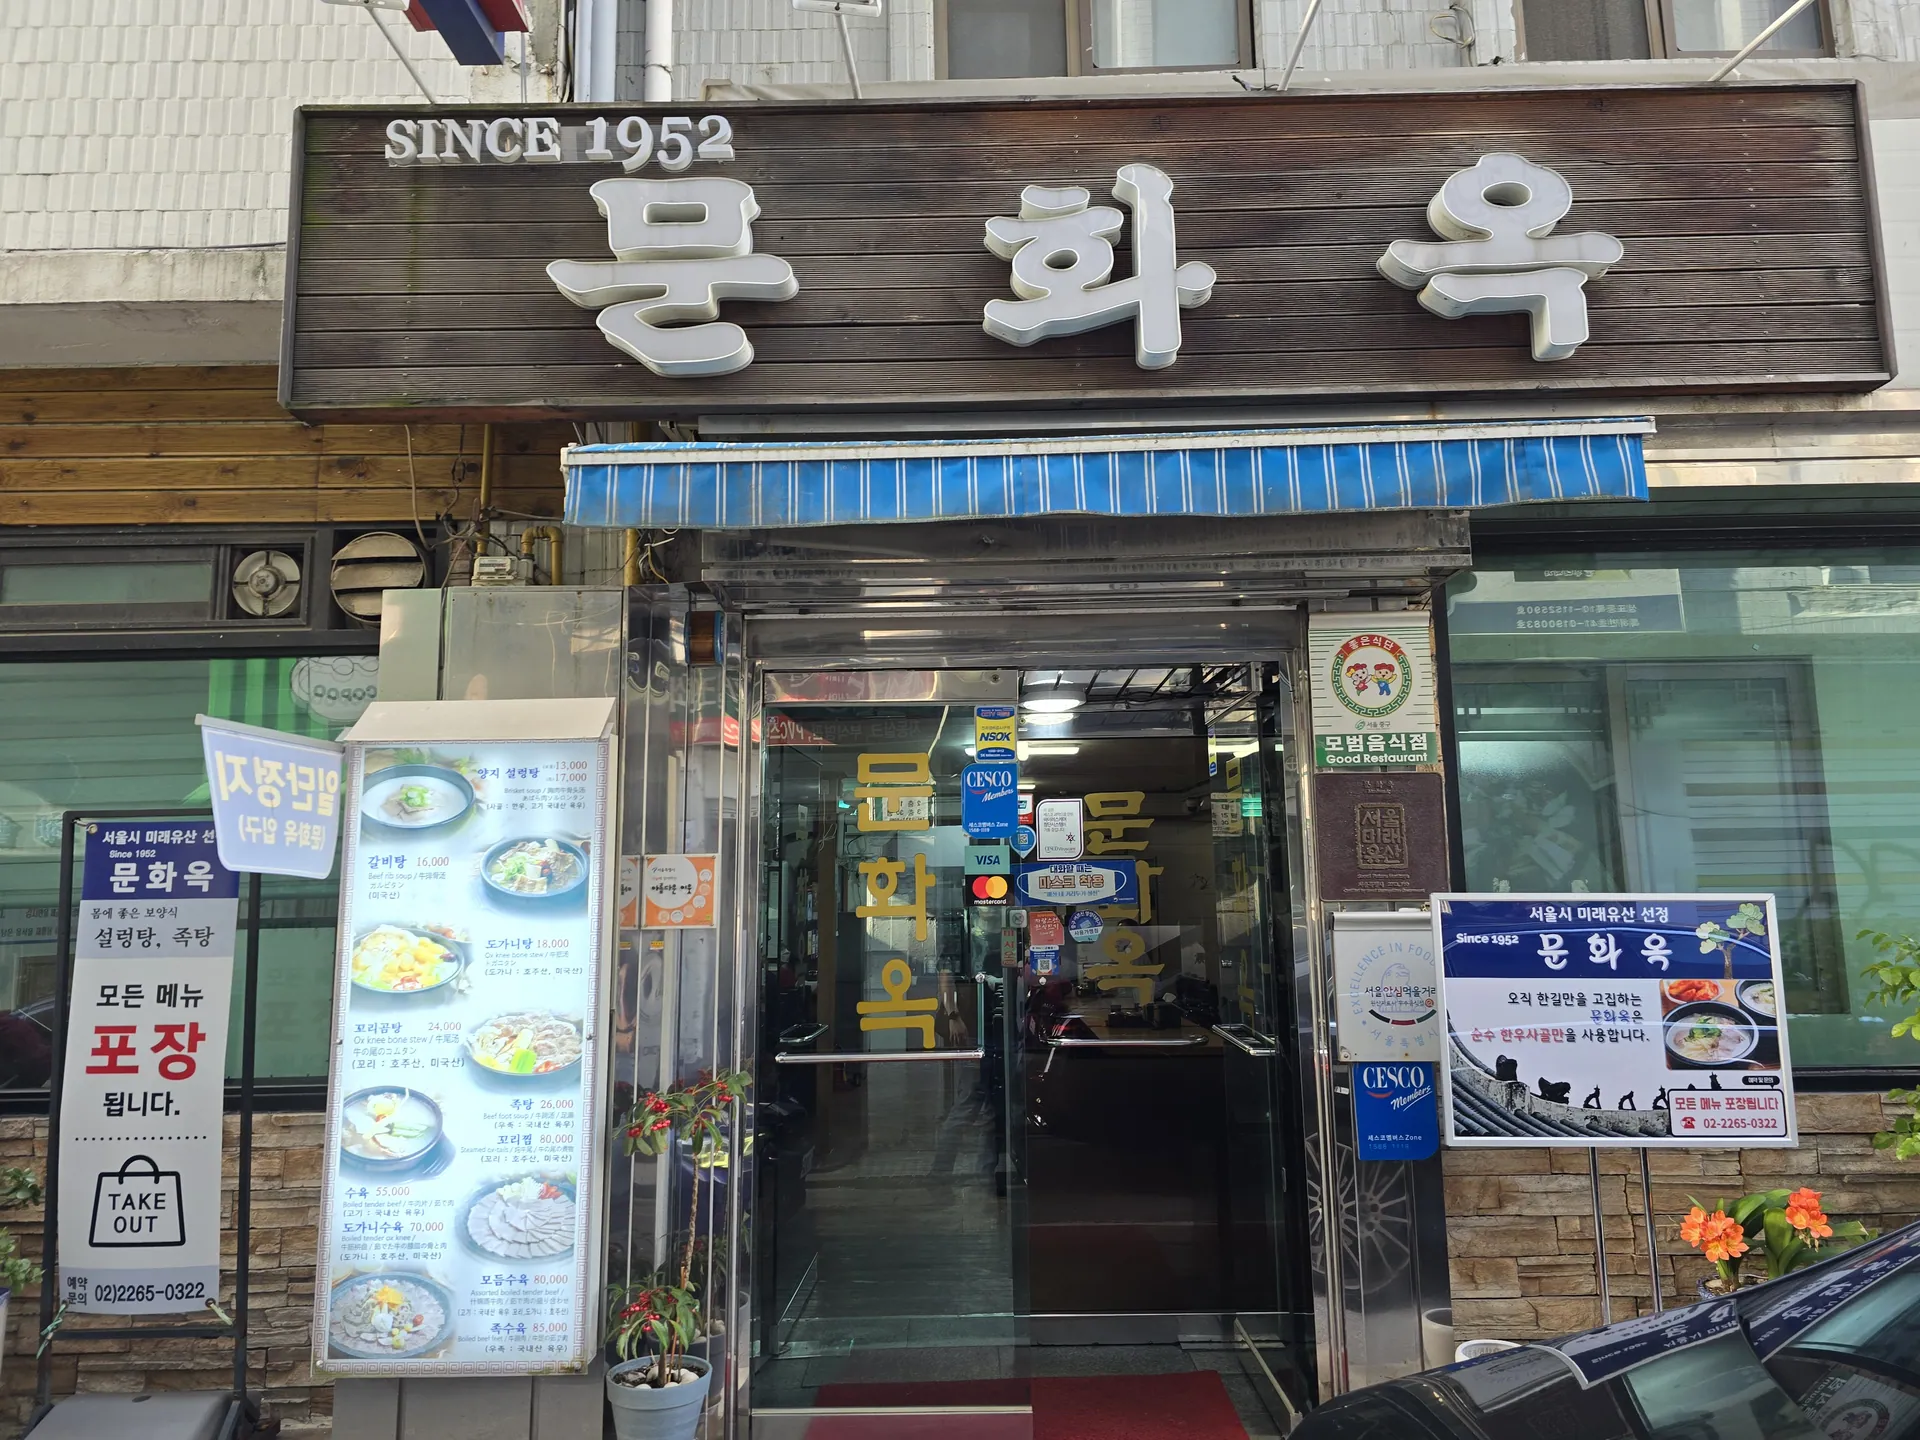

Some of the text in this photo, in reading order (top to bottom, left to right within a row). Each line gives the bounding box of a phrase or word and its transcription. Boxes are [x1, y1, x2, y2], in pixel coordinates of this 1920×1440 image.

[384, 114, 735, 173] SINCE 1952
[545, 152, 1625, 379] 문화옥
[1366, 720, 1377, 729] 서울
[979, 732, 1012, 741] NSOK
[1325, 733, 1428, 753] 모범음식점
[1326, 752, 1427, 764] Good Restaurant
[477, 768, 500, 779] 양지
[505, 767, 540, 779] 설렁탕
[555, 761, 587, 771] 13,000
[555, 773, 587, 782] 17,000
[966, 770, 1012, 787] CESCO
[981, 787, 1014, 803] Members
[102, 829, 197, 846] 서울시 미래유산
[109, 849, 156, 858] Since 1952
[974, 855, 1000, 865] VISA
[368, 855, 449, 869] 갈비탕 16,000
[1049, 864, 1092, 873] 대화할 때는
[109, 860, 214, 893] 문화옥
[1038, 874, 1104, 889] 마스크 착용
[651, 883, 692, 895] 아름다운 이웃
[854, 753, 939, 1049] 문화옥
[90, 907, 113, 919] 몸에
[117, 907, 140, 919] 좋은
[144, 906, 178, 919] 보양식
[1530, 906, 1668, 923] 서울시 미래유산 선정
[94, 927, 161, 949] 설렁탕,
[172, 926, 215, 947] 족탕
[485, 938, 533, 949] 도가니탕
[1456, 933, 1519, 945] Since 1952
[1537, 932, 1673, 971] 문화옥
[1350, 945, 1384, 1015] EXCELLENCE
[1389, 942, 1403, 953] IN
[96, 983, 203, 1008] 모든 메뉴
[1508, 991, 1642, 1007] 오직 한길만을 고집하는
[1589, 1009, 1643, 1023] 문화옥은
[428, 1022, 461, 1031] 24,000
[1470, 1028, 1650, 1044] 순수 한우사골만을 사용합니다.
[85, 1021, 207, 1080] 포장
[431, 1058, 465, 1067] 미국산)
[1362, 1066, 1425, 1090] CESCO
[103, 1091, 180, 1117] 됩니다.
[510, 1098, 574, 1110] 족탕 26,000
[1390, 1085, 1431, 1111] Members
[1675, 1097, 1779, 1111] 모든 메뉴 포장됩니다
[1703, 1117, 1777, 1129] 02-2265-0322
[497, 1134, 573, 1145] 꼬리찜 80,000
[345, 1187, 410, 1199] 수육 55,000
[108, 1193, 166, 1210] TAKE
[113, 1216, 158, 1233] OUT
[342, 1221, 444, 1233] 도가니수육 70,000
[67, 1276, 88, 1290] 예약
[480, 1274, 568, 1286] 모듬수육 80,000
[94, 1282, 205, 1303] 02)2265-0322
[491, 1322, 567, 1335] 족수육 85,000
